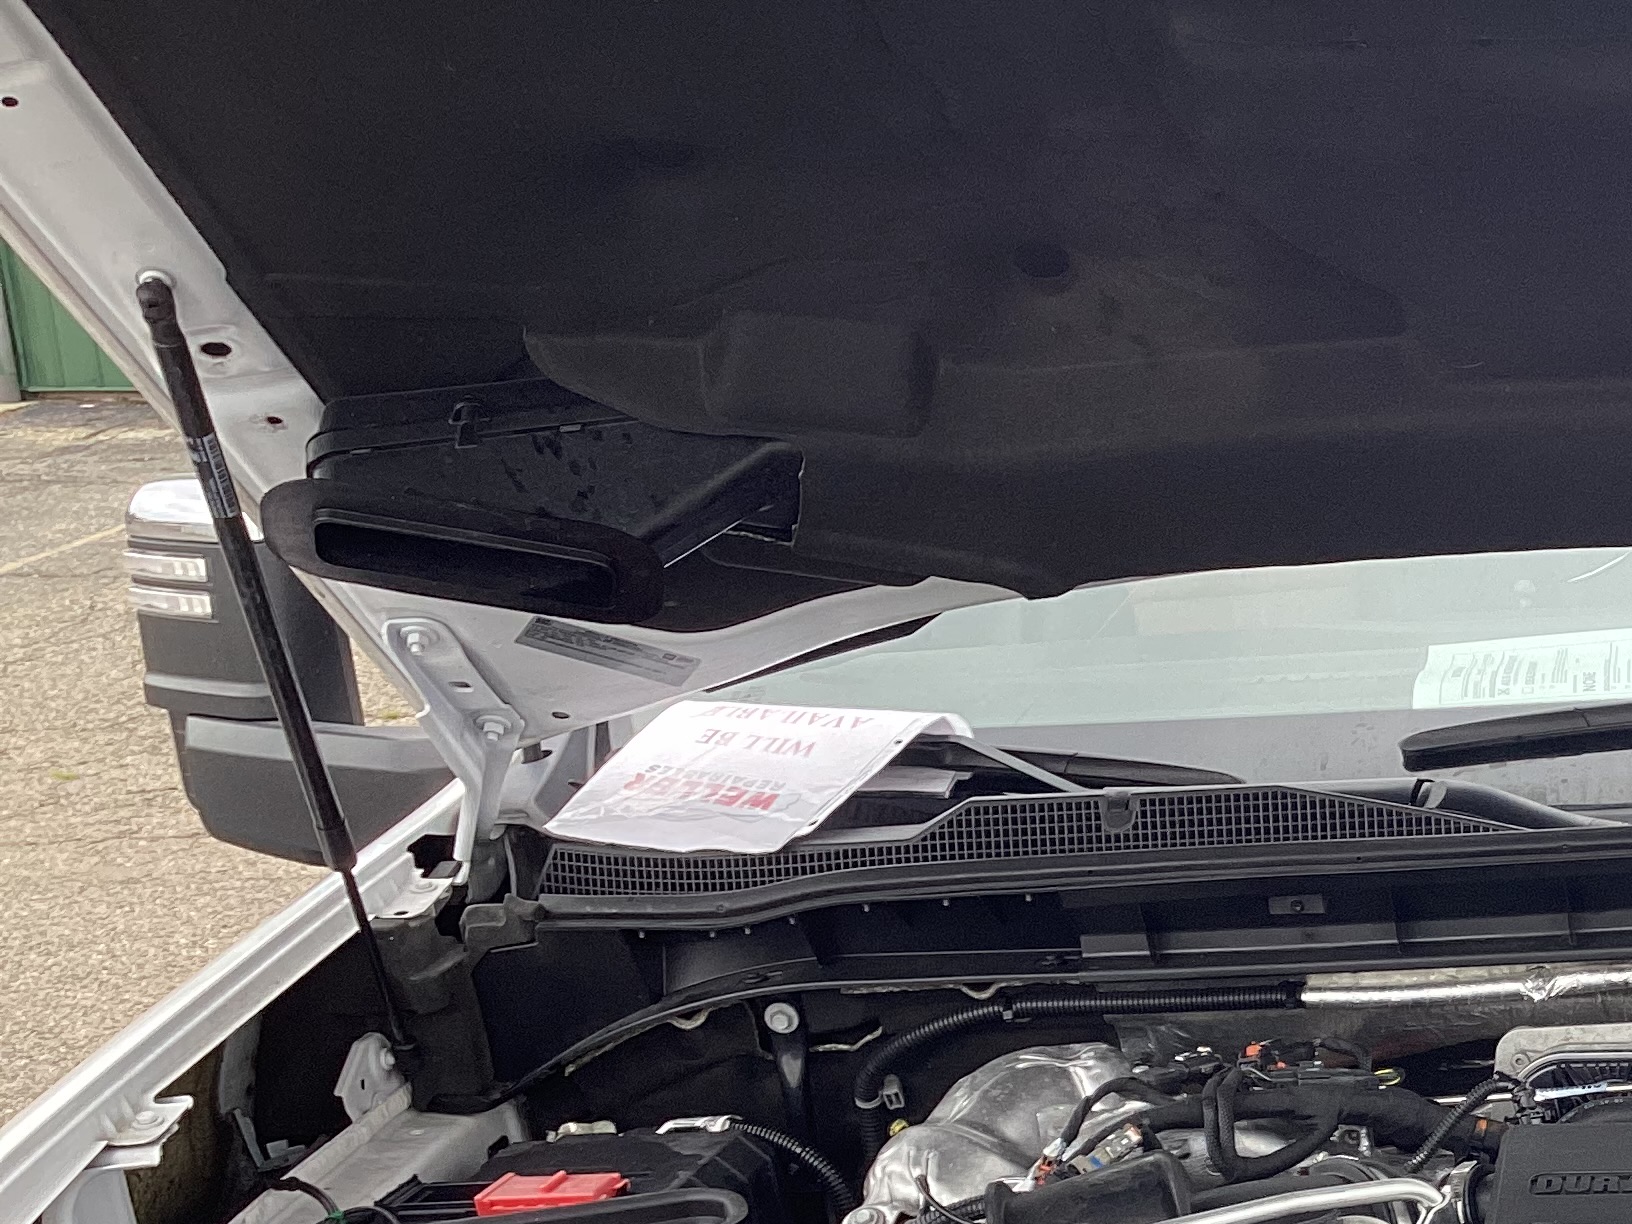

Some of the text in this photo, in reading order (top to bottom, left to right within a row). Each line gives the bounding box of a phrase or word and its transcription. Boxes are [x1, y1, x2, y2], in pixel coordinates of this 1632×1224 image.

[690, 705, 876, 730] AVAILABLE
[694, 728, 817, 758] WILL BE
